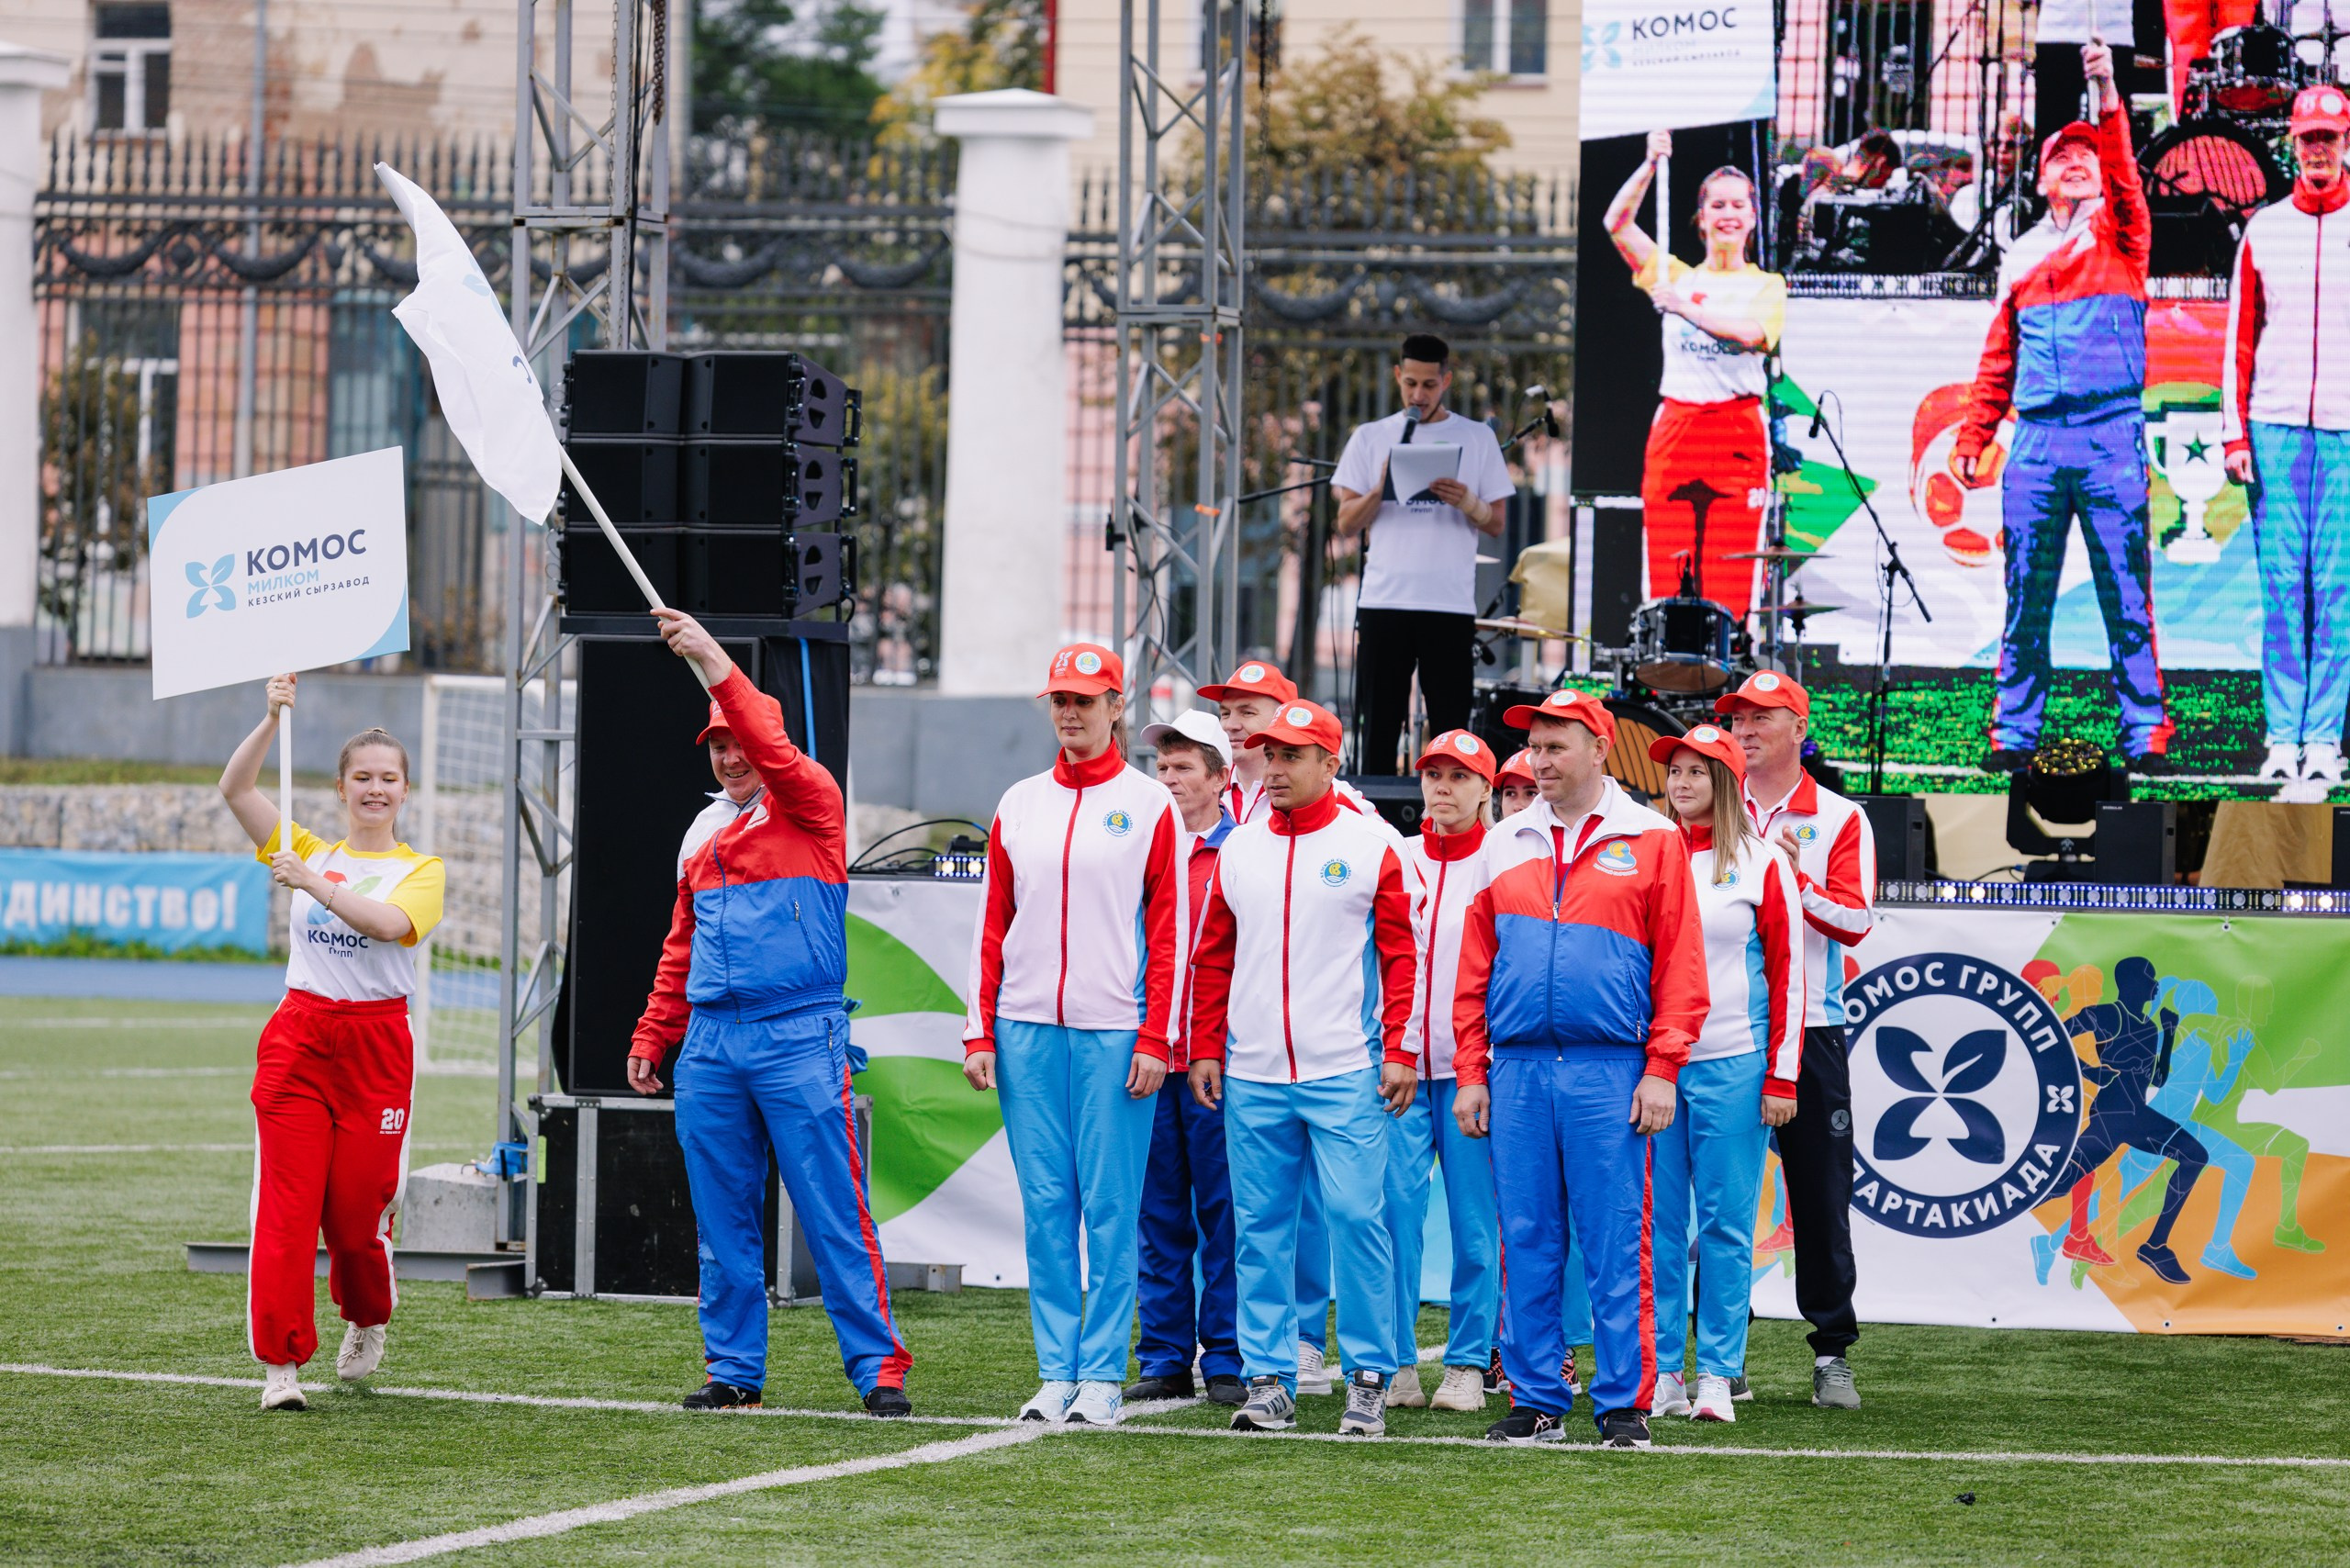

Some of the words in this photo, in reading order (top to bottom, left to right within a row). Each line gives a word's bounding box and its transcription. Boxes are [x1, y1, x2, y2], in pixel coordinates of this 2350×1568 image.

[1632, 7, 1737, 39] КОМОС
[247, 529, 366, 577] КОМОС
[247, 569, 319, 595] МИЛКОМ
[248, 588, 301, 607] КЕЗСКИЙ
[306, 576, 370, 596] СЫРЗАВОД
[0, 880, 239, 931] ДИНСТВО!
[308, 929, 369, 948] КОМОС
[1844, 962, 1946, 1037] ОМОС
[1958, 965, 2059, 1053] ГРУПП
[381, 1107, 405, 1130] 20
